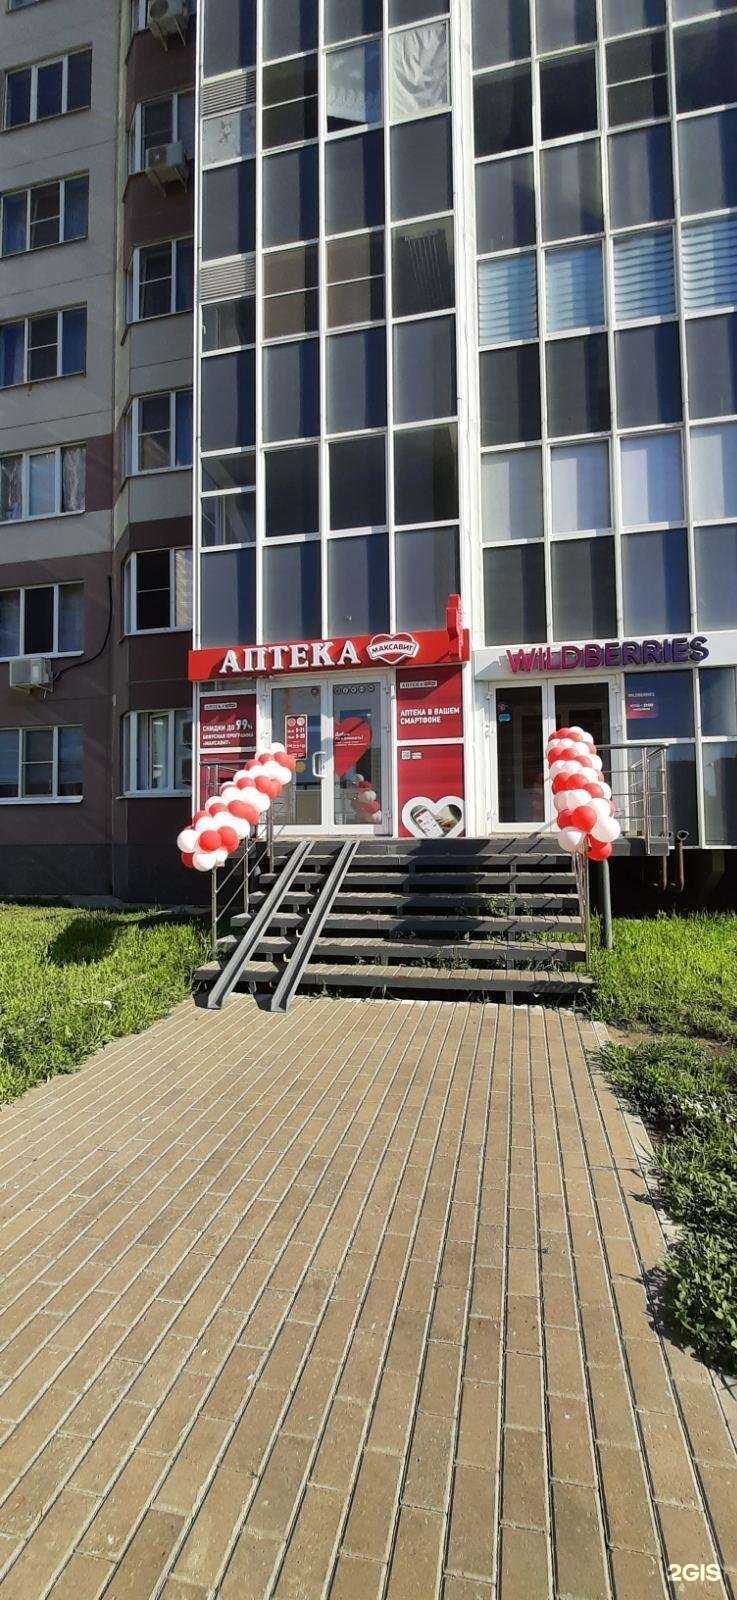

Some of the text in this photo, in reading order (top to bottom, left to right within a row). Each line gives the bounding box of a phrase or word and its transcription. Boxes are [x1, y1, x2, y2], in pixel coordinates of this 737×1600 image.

[371, 642, 413, 654] МАКСАВИТ
[219, 640, 361, 674] АПТЕКА
[506, 636, 710, 673] WILDBERRIES
[401, 708, 426, 717] АПТЕКА
[434, 706, 460, 716] ВАШЕМ
[401, 716, 442, 725] СМАРТФОНЕ
[203, 725, 225, 733] СКИДКИ
[226, 724, 235, 732] ДО
